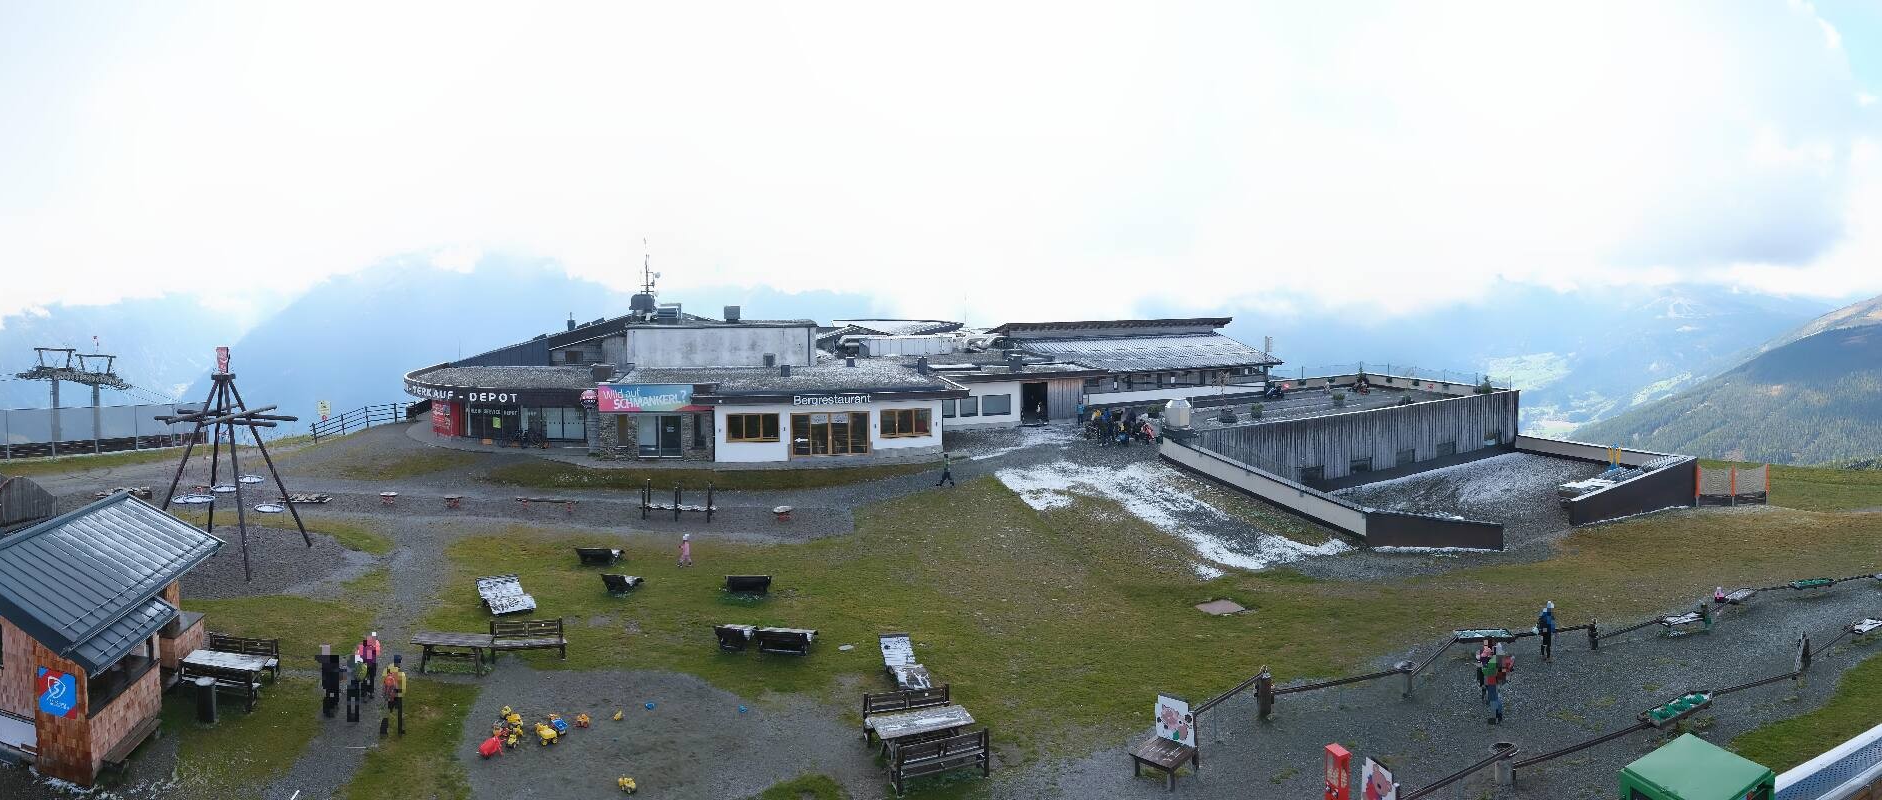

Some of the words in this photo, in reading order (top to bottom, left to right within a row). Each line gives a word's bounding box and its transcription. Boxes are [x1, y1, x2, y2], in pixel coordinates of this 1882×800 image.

[469, 392, 517, 402] DEPOT
[603, 389, 623, 400] Wild
[625, 387, 641, 398] auf
[614, 390, 687, 410] SCHMANKERL?
[793, 394, 871, 407] Bergrestaurant
